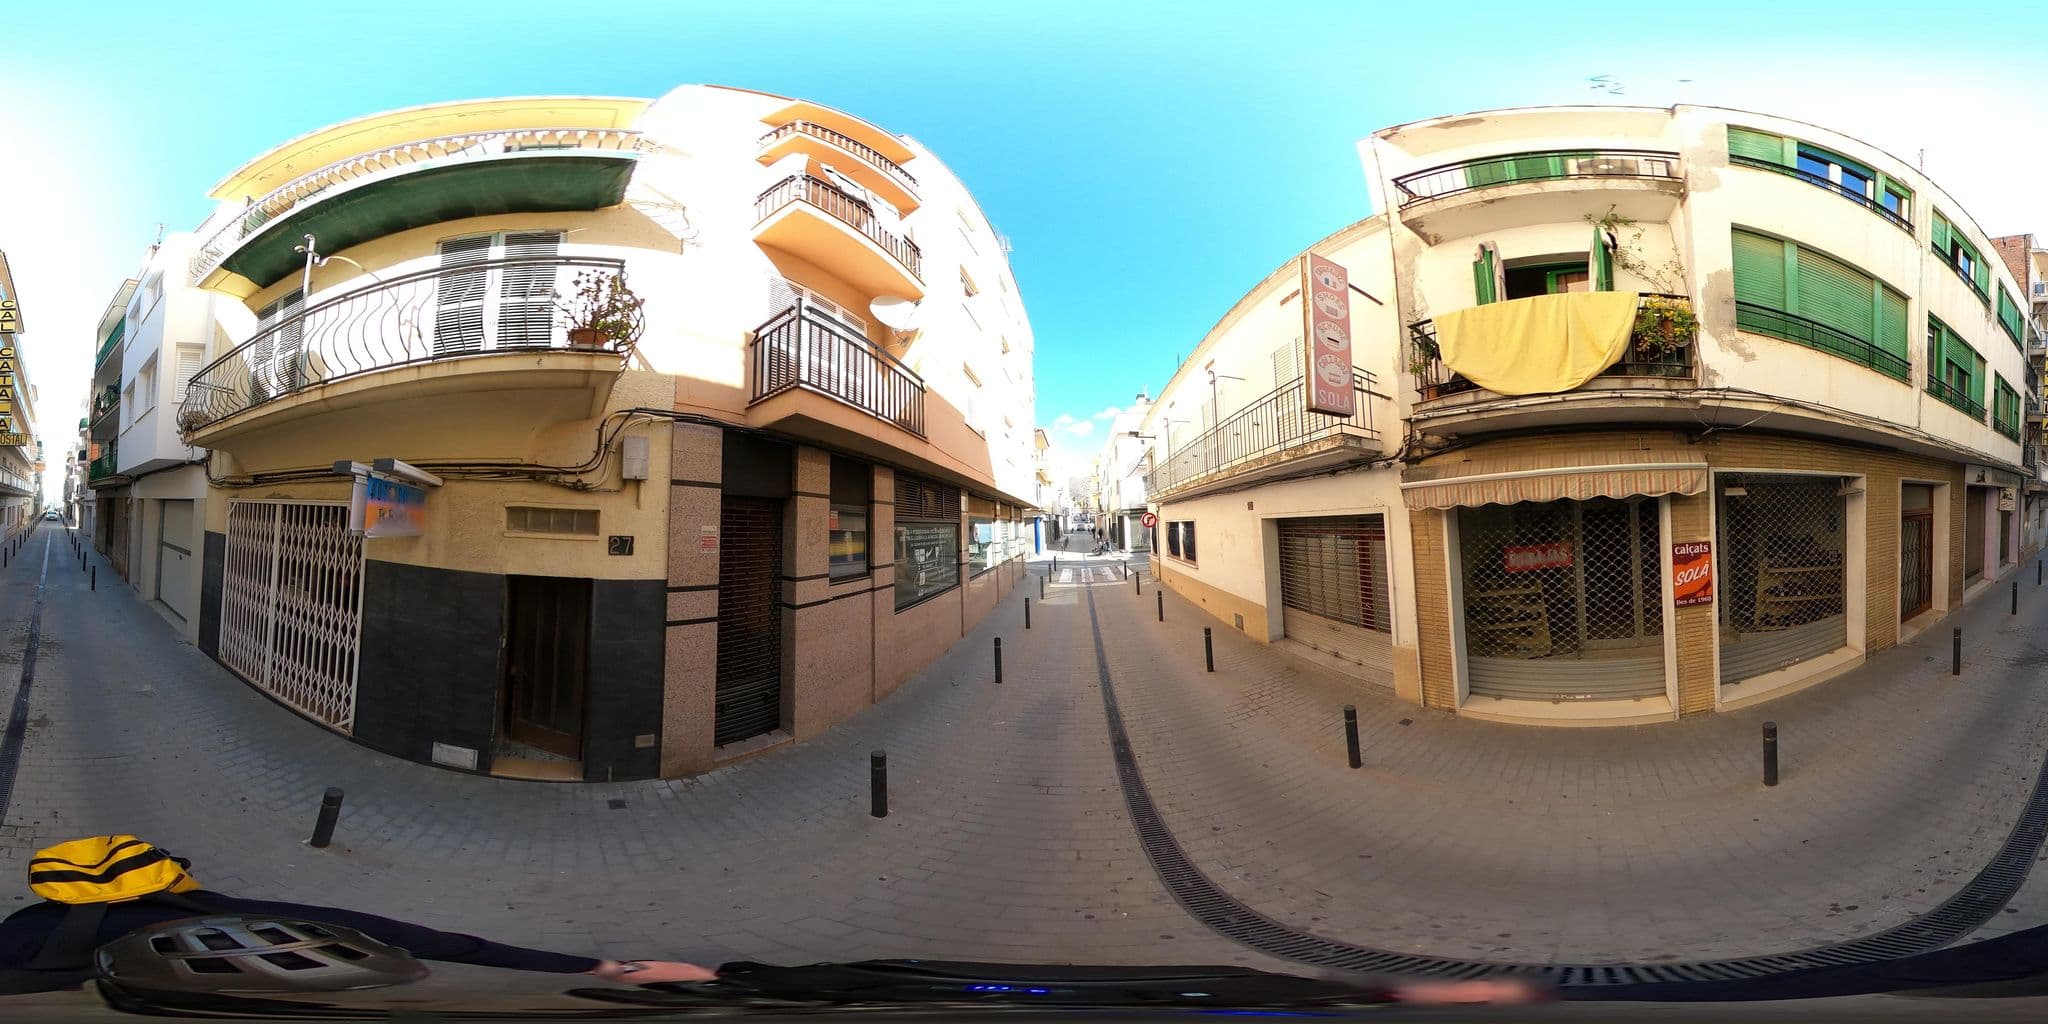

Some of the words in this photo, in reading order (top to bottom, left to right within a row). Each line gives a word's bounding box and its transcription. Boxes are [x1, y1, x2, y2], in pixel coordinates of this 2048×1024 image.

[1, 300, 14, 332] CAL
[609, 536, 633, 554] 27
[1674, 543, 1709, 557] calçats
